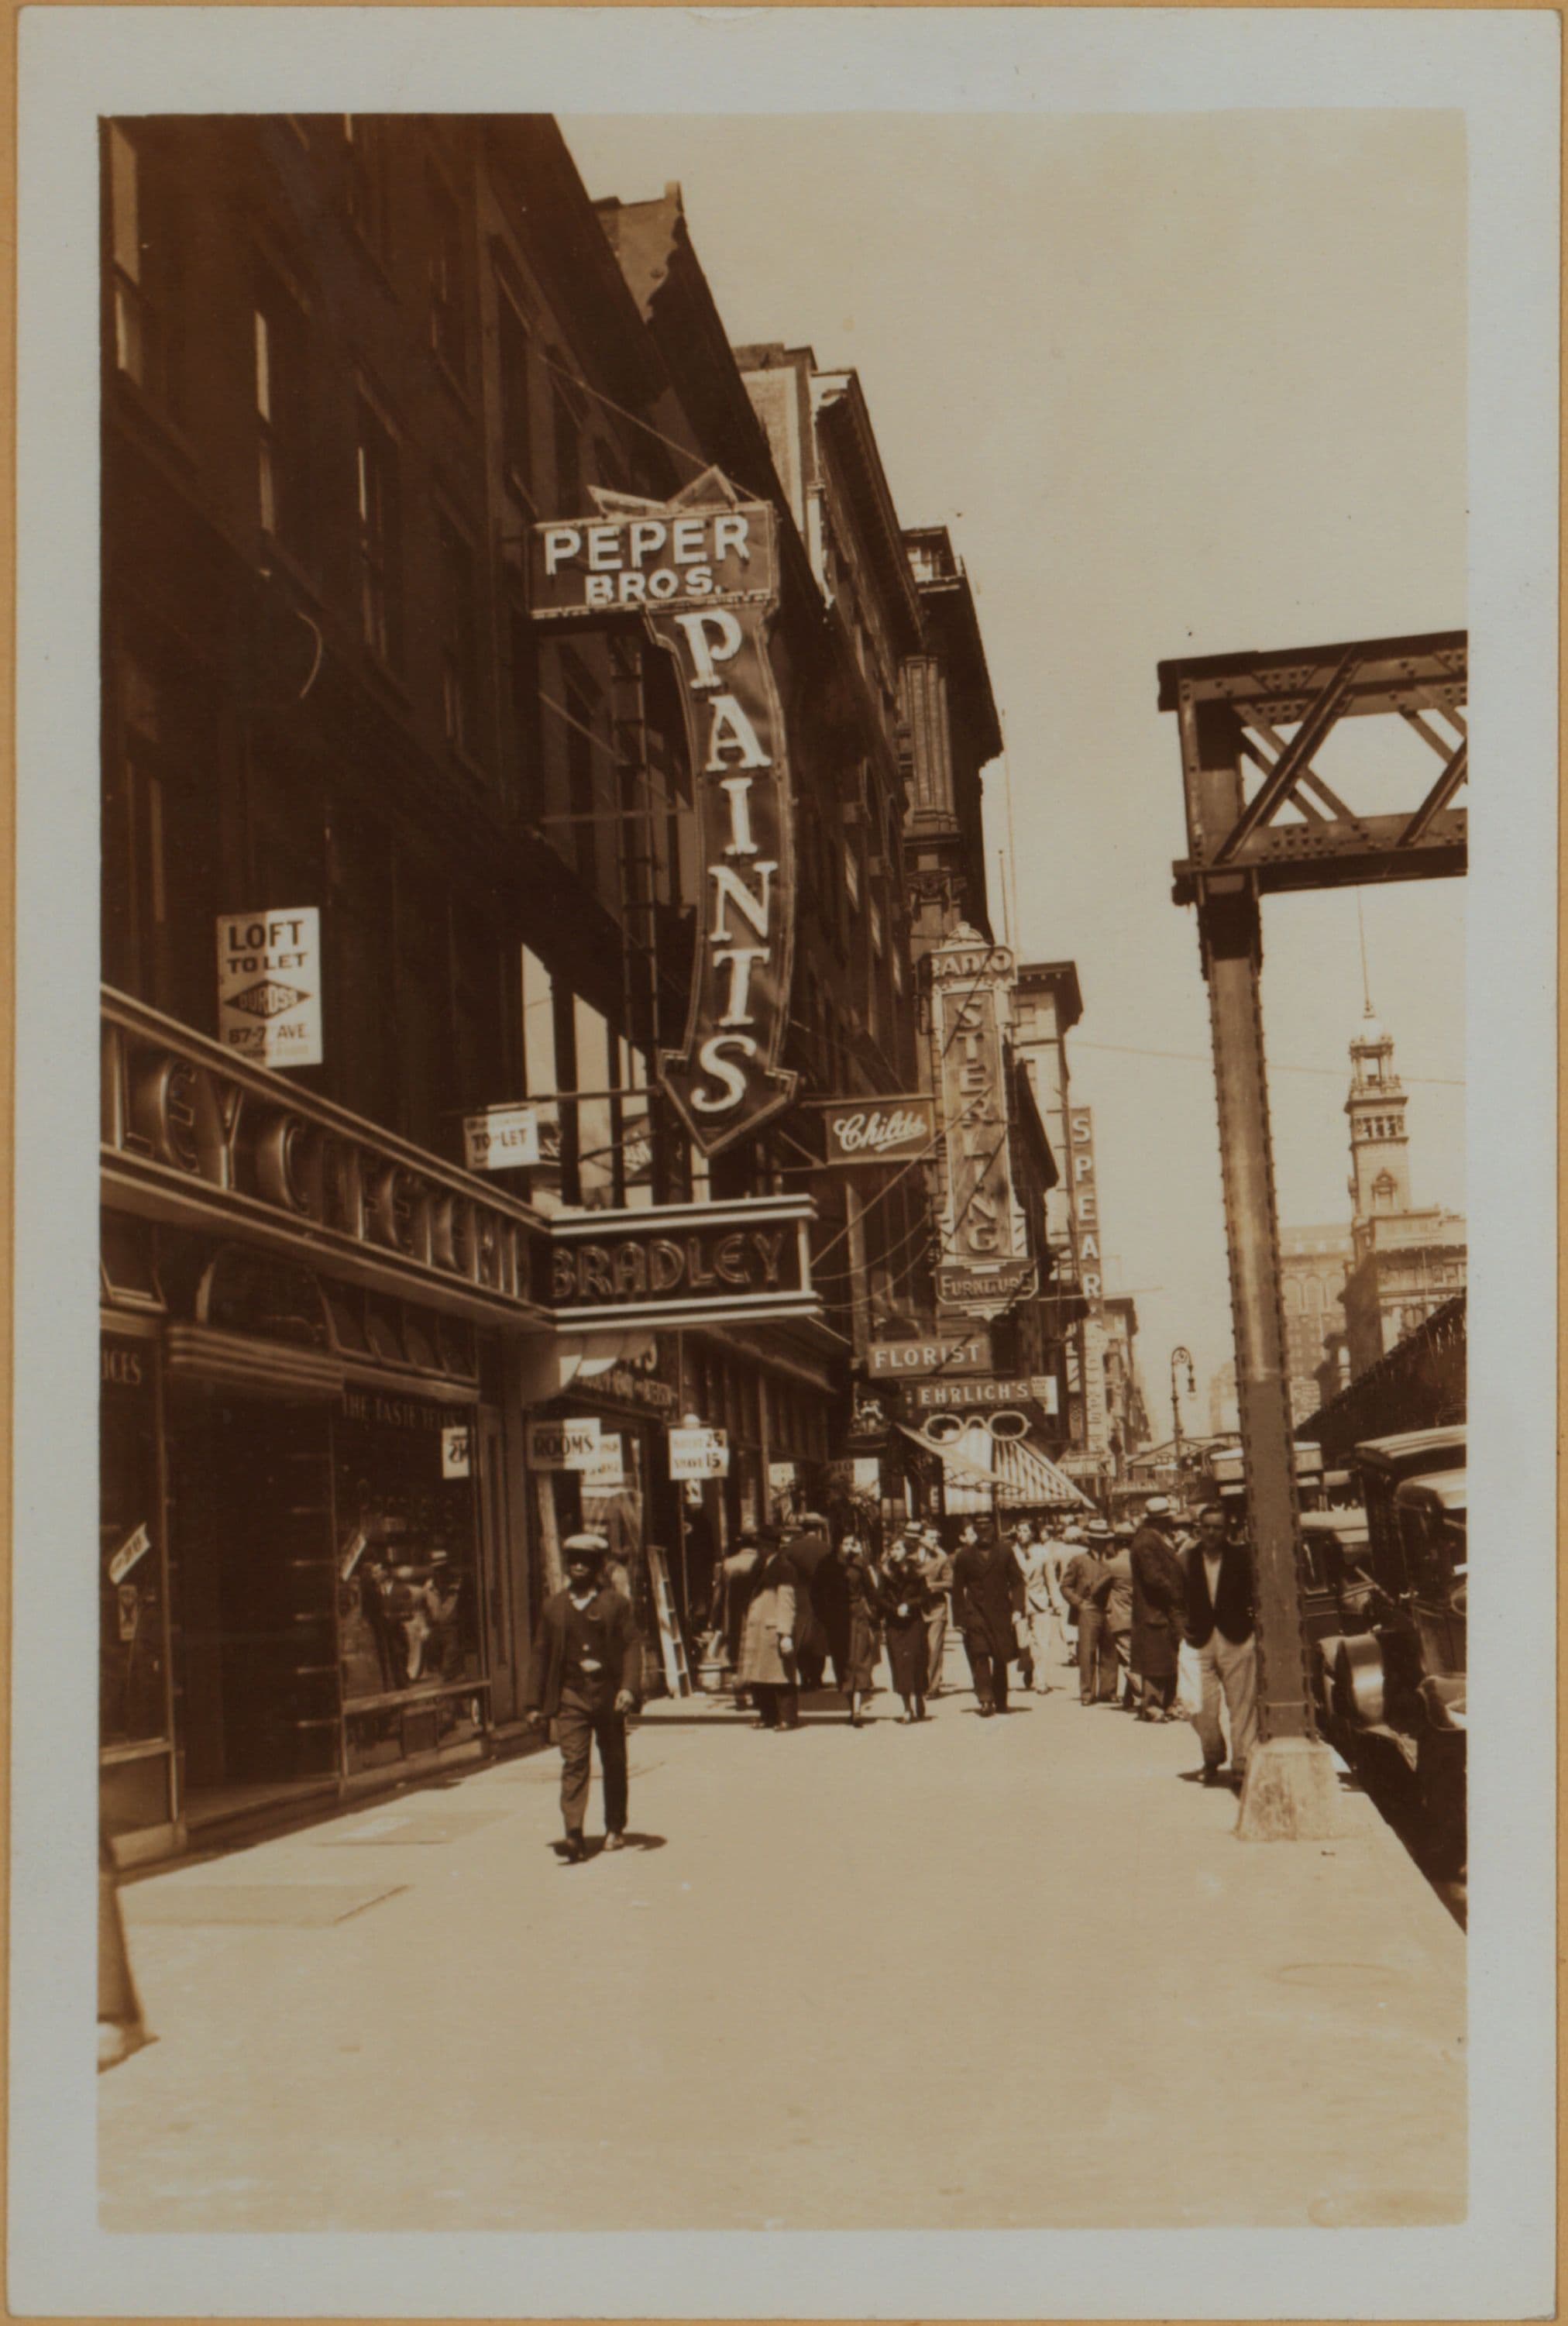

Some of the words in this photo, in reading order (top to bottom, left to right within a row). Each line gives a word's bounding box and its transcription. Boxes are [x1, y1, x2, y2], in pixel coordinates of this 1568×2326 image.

[544, 515, 751, 576] PEPER
[584, 565, 723, 606] BROS.
[675, 607, 779, 1114] PAINTS
[228, 920, 304, 952] LOFT
[225, 956, 260, 975] TO
[263, 951, 309, 971] LET
[930, 950, 1013, 977] RADIO
[833, 1108, 929, 1153] Childs
[956, 1000, 999, 1253] STERLING
[1071, 1116, 1101, 1299] SPEAR
[551, 1233, 785, 1298] BRADLEY
[940, 1270, 1033, 1298] FURNITURE
[873, 1344, 980, 1369] FLORIST
[919, 1381, 1030, 1406] EHRLICH'S
[533, 1433, 595, 1457] ROOMS
